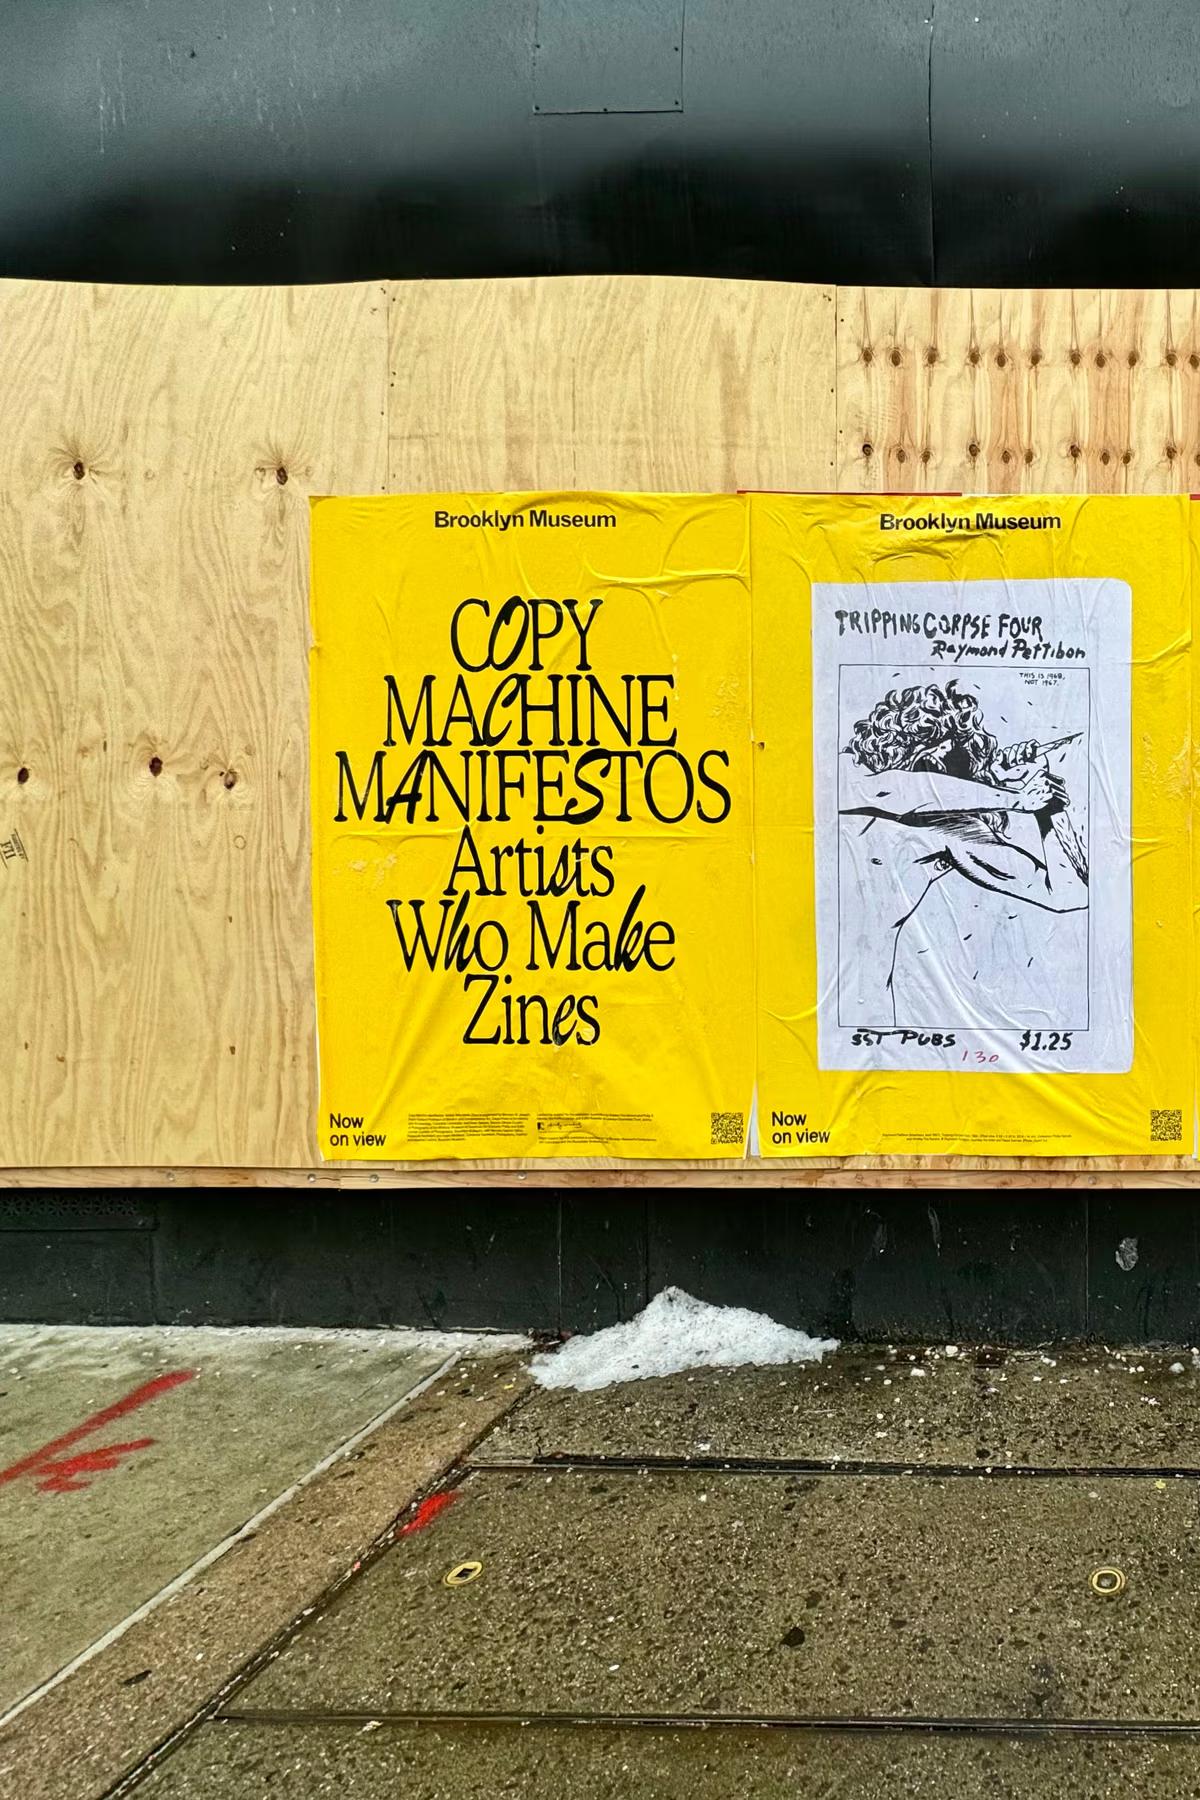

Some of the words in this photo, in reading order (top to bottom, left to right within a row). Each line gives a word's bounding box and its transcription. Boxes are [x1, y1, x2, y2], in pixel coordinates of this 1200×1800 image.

[434, 510, 525, 531] Brooklyn
[529, 509, 616, 528] Museum
[879, 513, 971, 534] Brooklyn
[975, 512, 1061, 530] Museum
[450, 595, 604, 672] COPY
[834, 608, 921, 639] TRIPPING
[923, 612, 992, 640] CORPSE
[998, 613, 1043, 642] FOUR
[930, 639, 1008, 663] Raymond
[382, 672, 678, 747] MACHINE
[333, 747, 731, 825] MANIFESTOS
[443, 824, 615, 898] Artists
[386, 889, 509, 972] Who
[525, 884, 676, 972] Make
[462, 973, 601, 1046] Zines
[1018, 1030, 1073, 1052] $1.25
[330, 1113, 364, 1129] Now
[771, 1111, 807, 1127] Now
[330, 1134, 349, 1146] on
[353, 1131, 387, 1147] view
[772, 1131, 792, 1144] on
[796, 1130, 830, 1144] view
